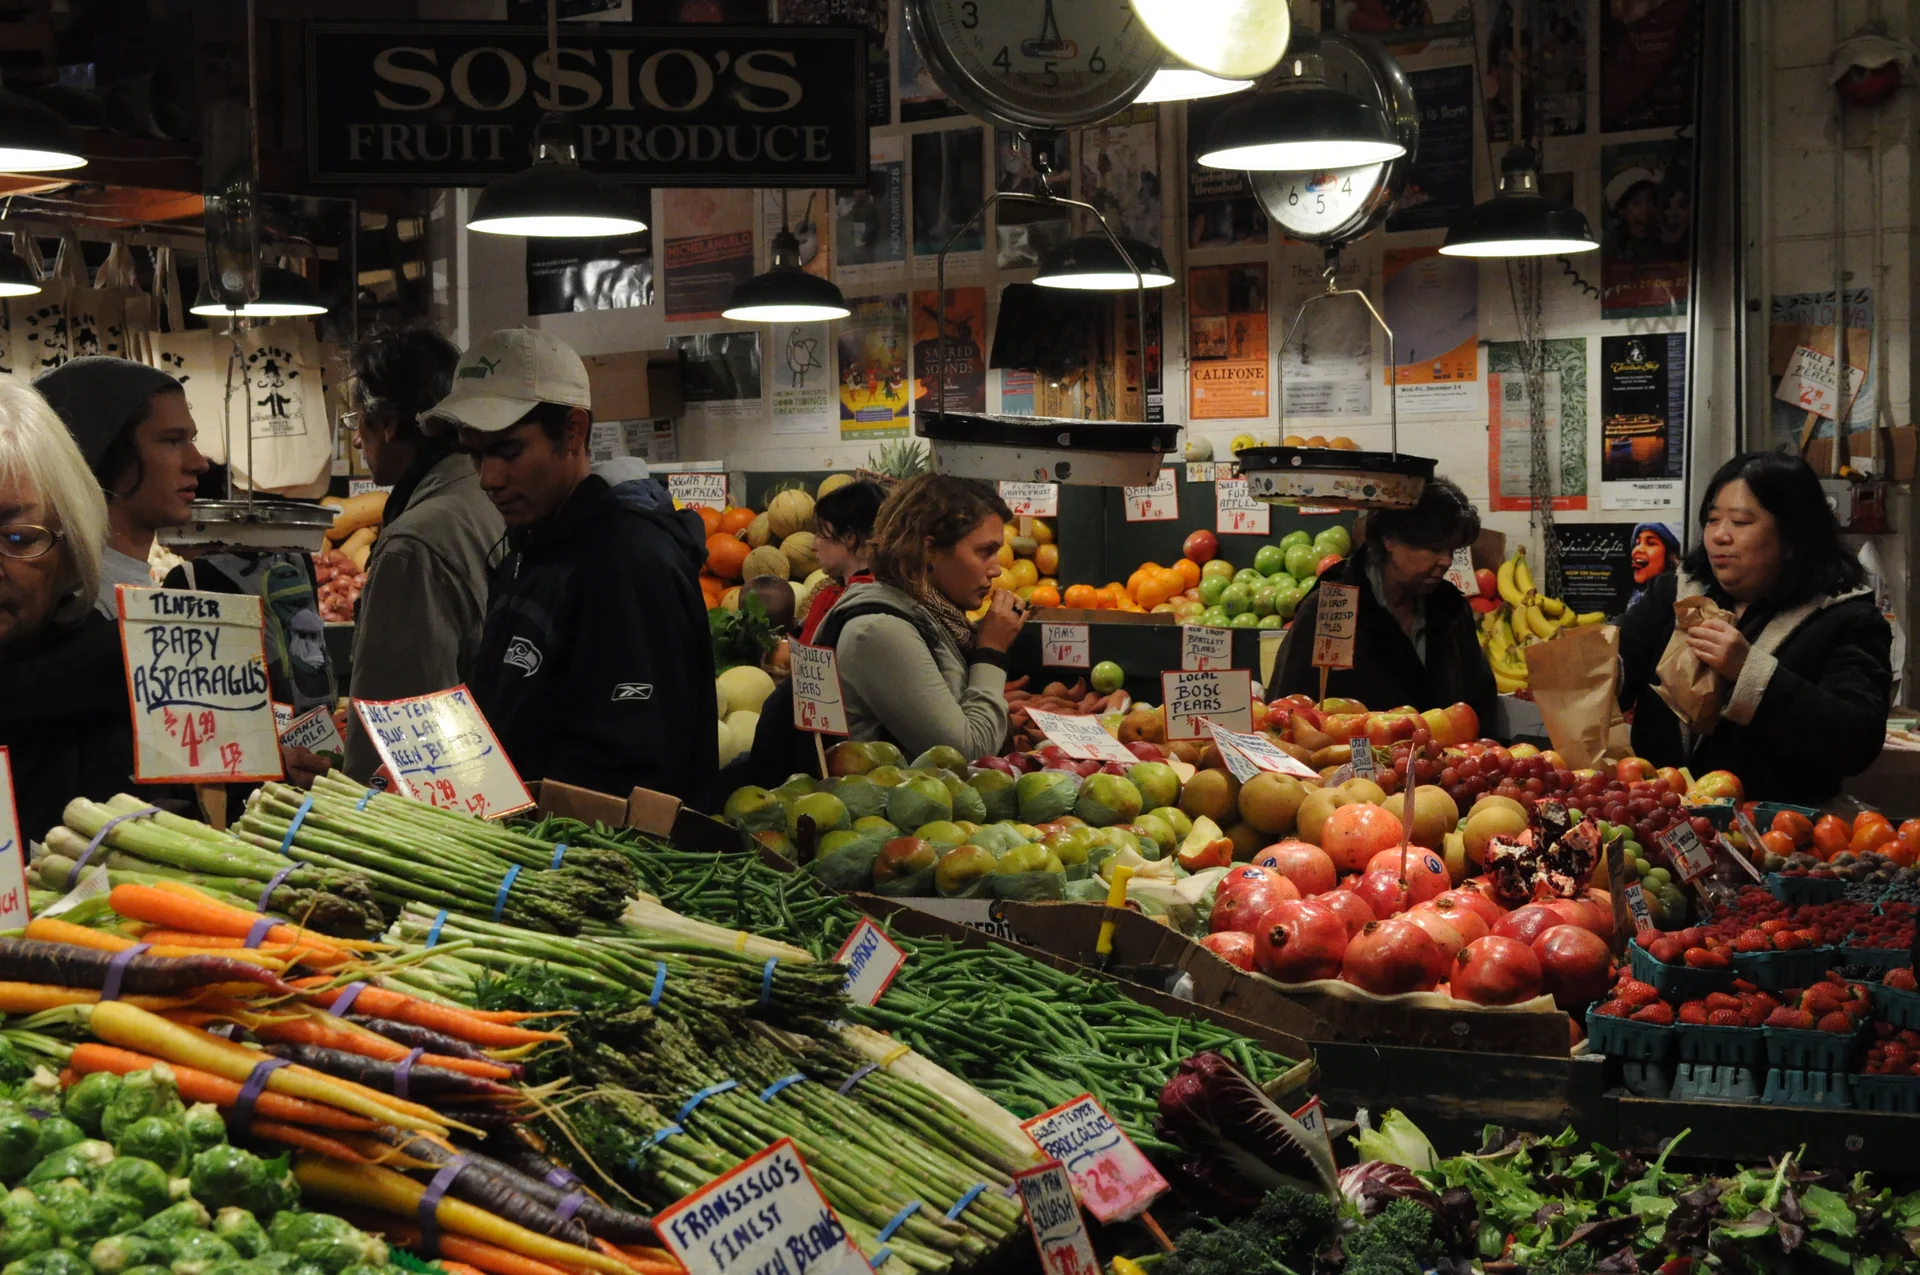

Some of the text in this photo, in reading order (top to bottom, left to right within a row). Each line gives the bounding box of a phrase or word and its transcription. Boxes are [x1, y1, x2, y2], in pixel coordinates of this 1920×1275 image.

[961, 0, 979, 29] 3
[992, 45, 1012, 73] 4
[1088, 46, 1107, 74] 6
[372, 46, 804, 113] SOSIO'S
[1042, 62, 1059, 88] 5
[346, 124, 513, 161] FRUIT
[580, 123, 832, 162] PRODUCE
[1288, 185, 1299, 206] 6
[1341, 176, 1353, 197] 4
[890, 168, 901, 256] NOVEMBER 28
[1315, 193, 1325, 215] 5
[666, 232, 750, 256] MICHELANGELO
[925, 345, 973, 358] SARED
[1194, 367, 1265, 381] CALIFONE
[773, 407, 796, 416] GREAT
[795, 396, 828, 406] TIDINGS
[669, 475, 724, 487] SUGAR PIE
[1125, 481, 1174, 497] ORANGES
[672, 487, 725, 498] PUMPKINS
[1000, 488, 1053, 498] GRAPEFRUIT
[1220, 498, 1259, 508] APPLES
[1328, 599, 1348, 608] CROP
[1330, 611, 1354, 621] CRISP
[1048, 627, 1075, 641] YAMS
[1186, 633, 1224, 646] BARTLETT
[1205, 626, 1226, 636] CROP
[144, 625, 220, 667] BABY
[133, 660, 269, 706] ASPARAGUS
[1178, 672, 1219, 684] LOCAL
[1175, 683, 1222, 700] BOSC
[1170, 698, 1222, 714] PEARS
[1038, 712, 1075, 722] LOCAL
[280, 714, 324, 746] RGANIC
[1062, 733, 1102, 745] PEARS
[391, 745, 423, 768] REEN
[847, 926, 880, 984] MARKET
[1042, 1114, 1116, 1161] BROCCOLINI
[1031, 1192, 1076, 1239] SQUASH
[709, 1202, 783, 1273] FINEST
[785, 1208, 846, 1275] BEANS
